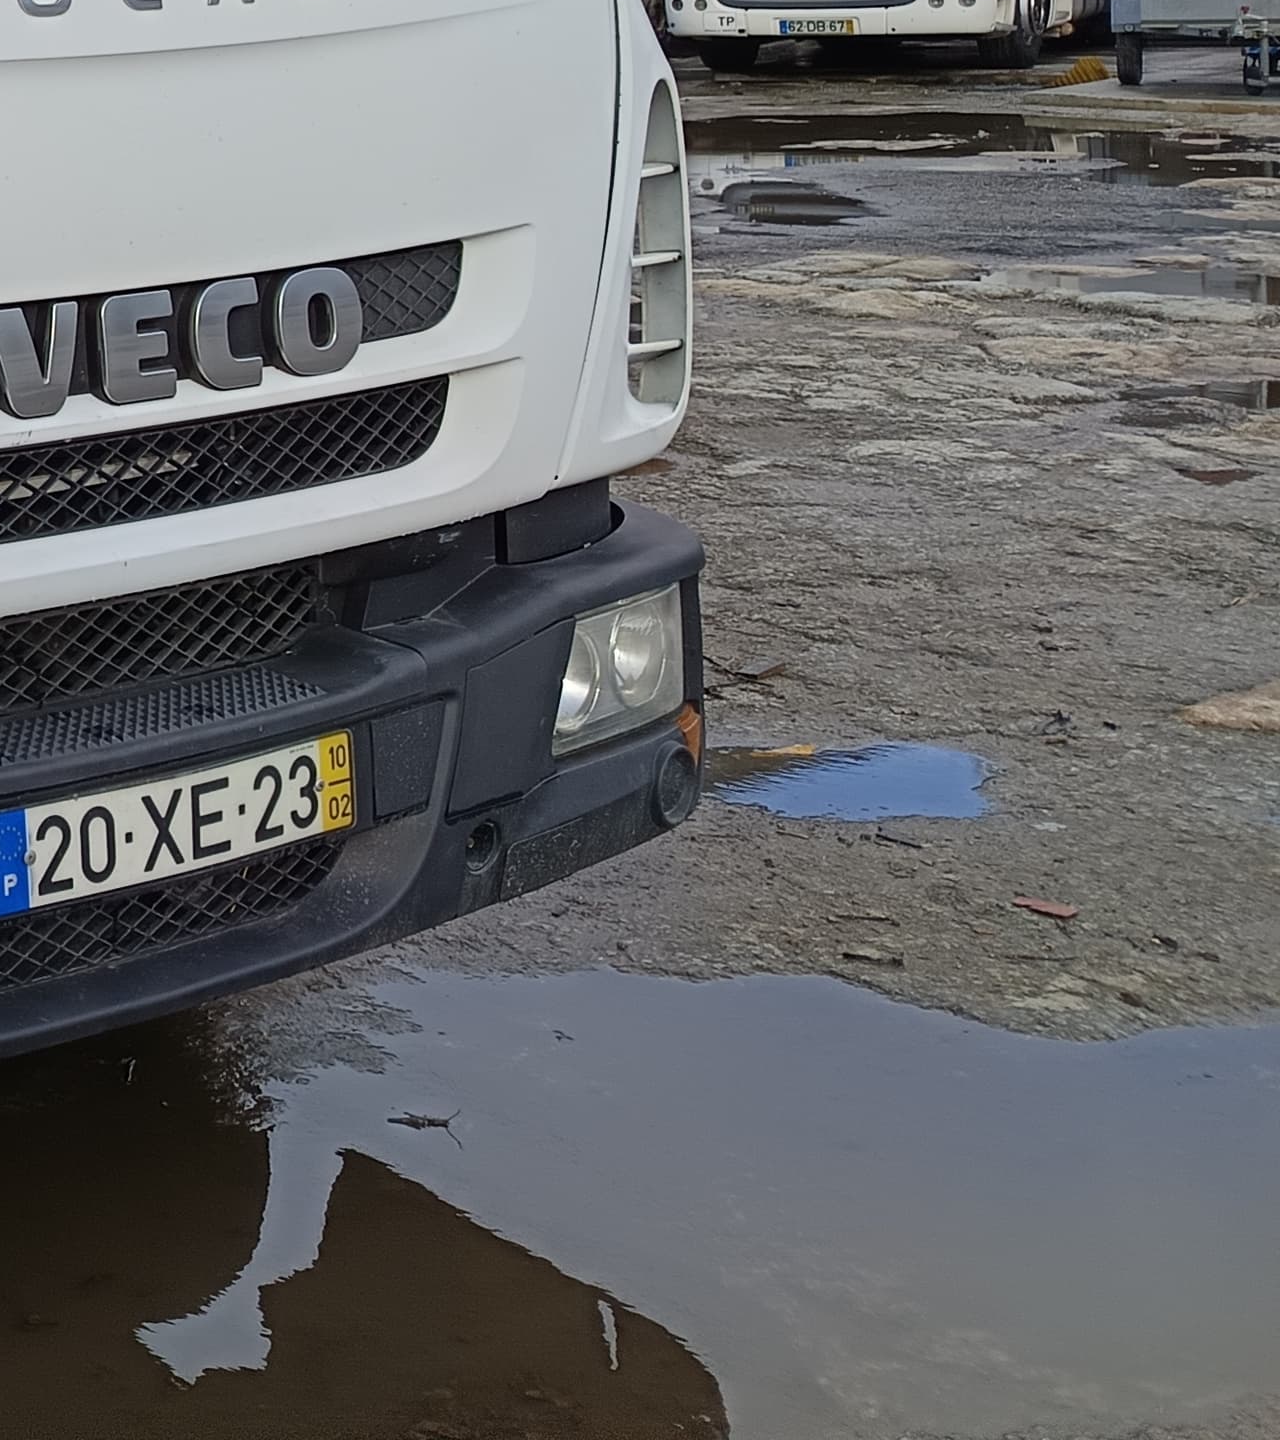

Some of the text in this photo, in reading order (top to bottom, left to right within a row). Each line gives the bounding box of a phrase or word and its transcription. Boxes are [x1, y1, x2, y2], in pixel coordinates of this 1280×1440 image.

[718, 16, 735, 26] TP
[327, 744, 347, 771] 10
[328, 794, 352, 821] 02
[3, 874, 19, 897] P
